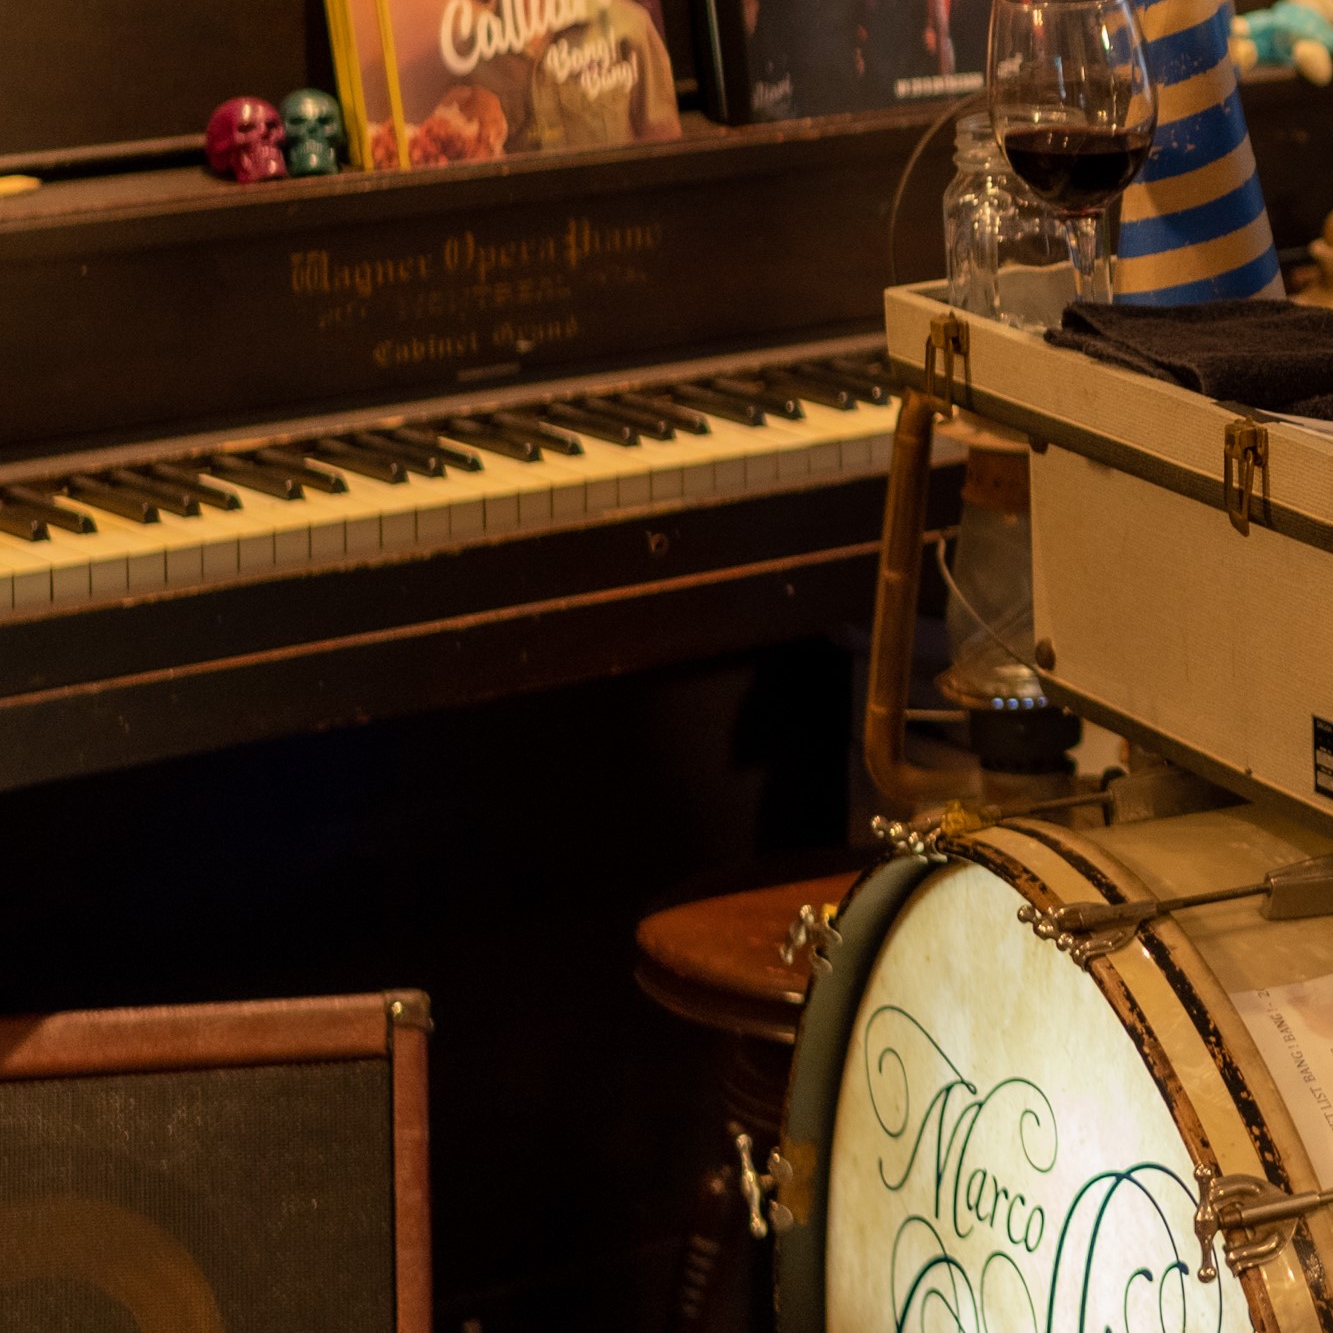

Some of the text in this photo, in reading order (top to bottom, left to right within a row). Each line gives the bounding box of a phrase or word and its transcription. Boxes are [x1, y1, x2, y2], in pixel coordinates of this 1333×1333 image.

[1271, 1013, 1296, 1042] BANG
[1291, 1051, 1315, 1082] BANG
[1310, 1085, 1332, 1109] LIST
